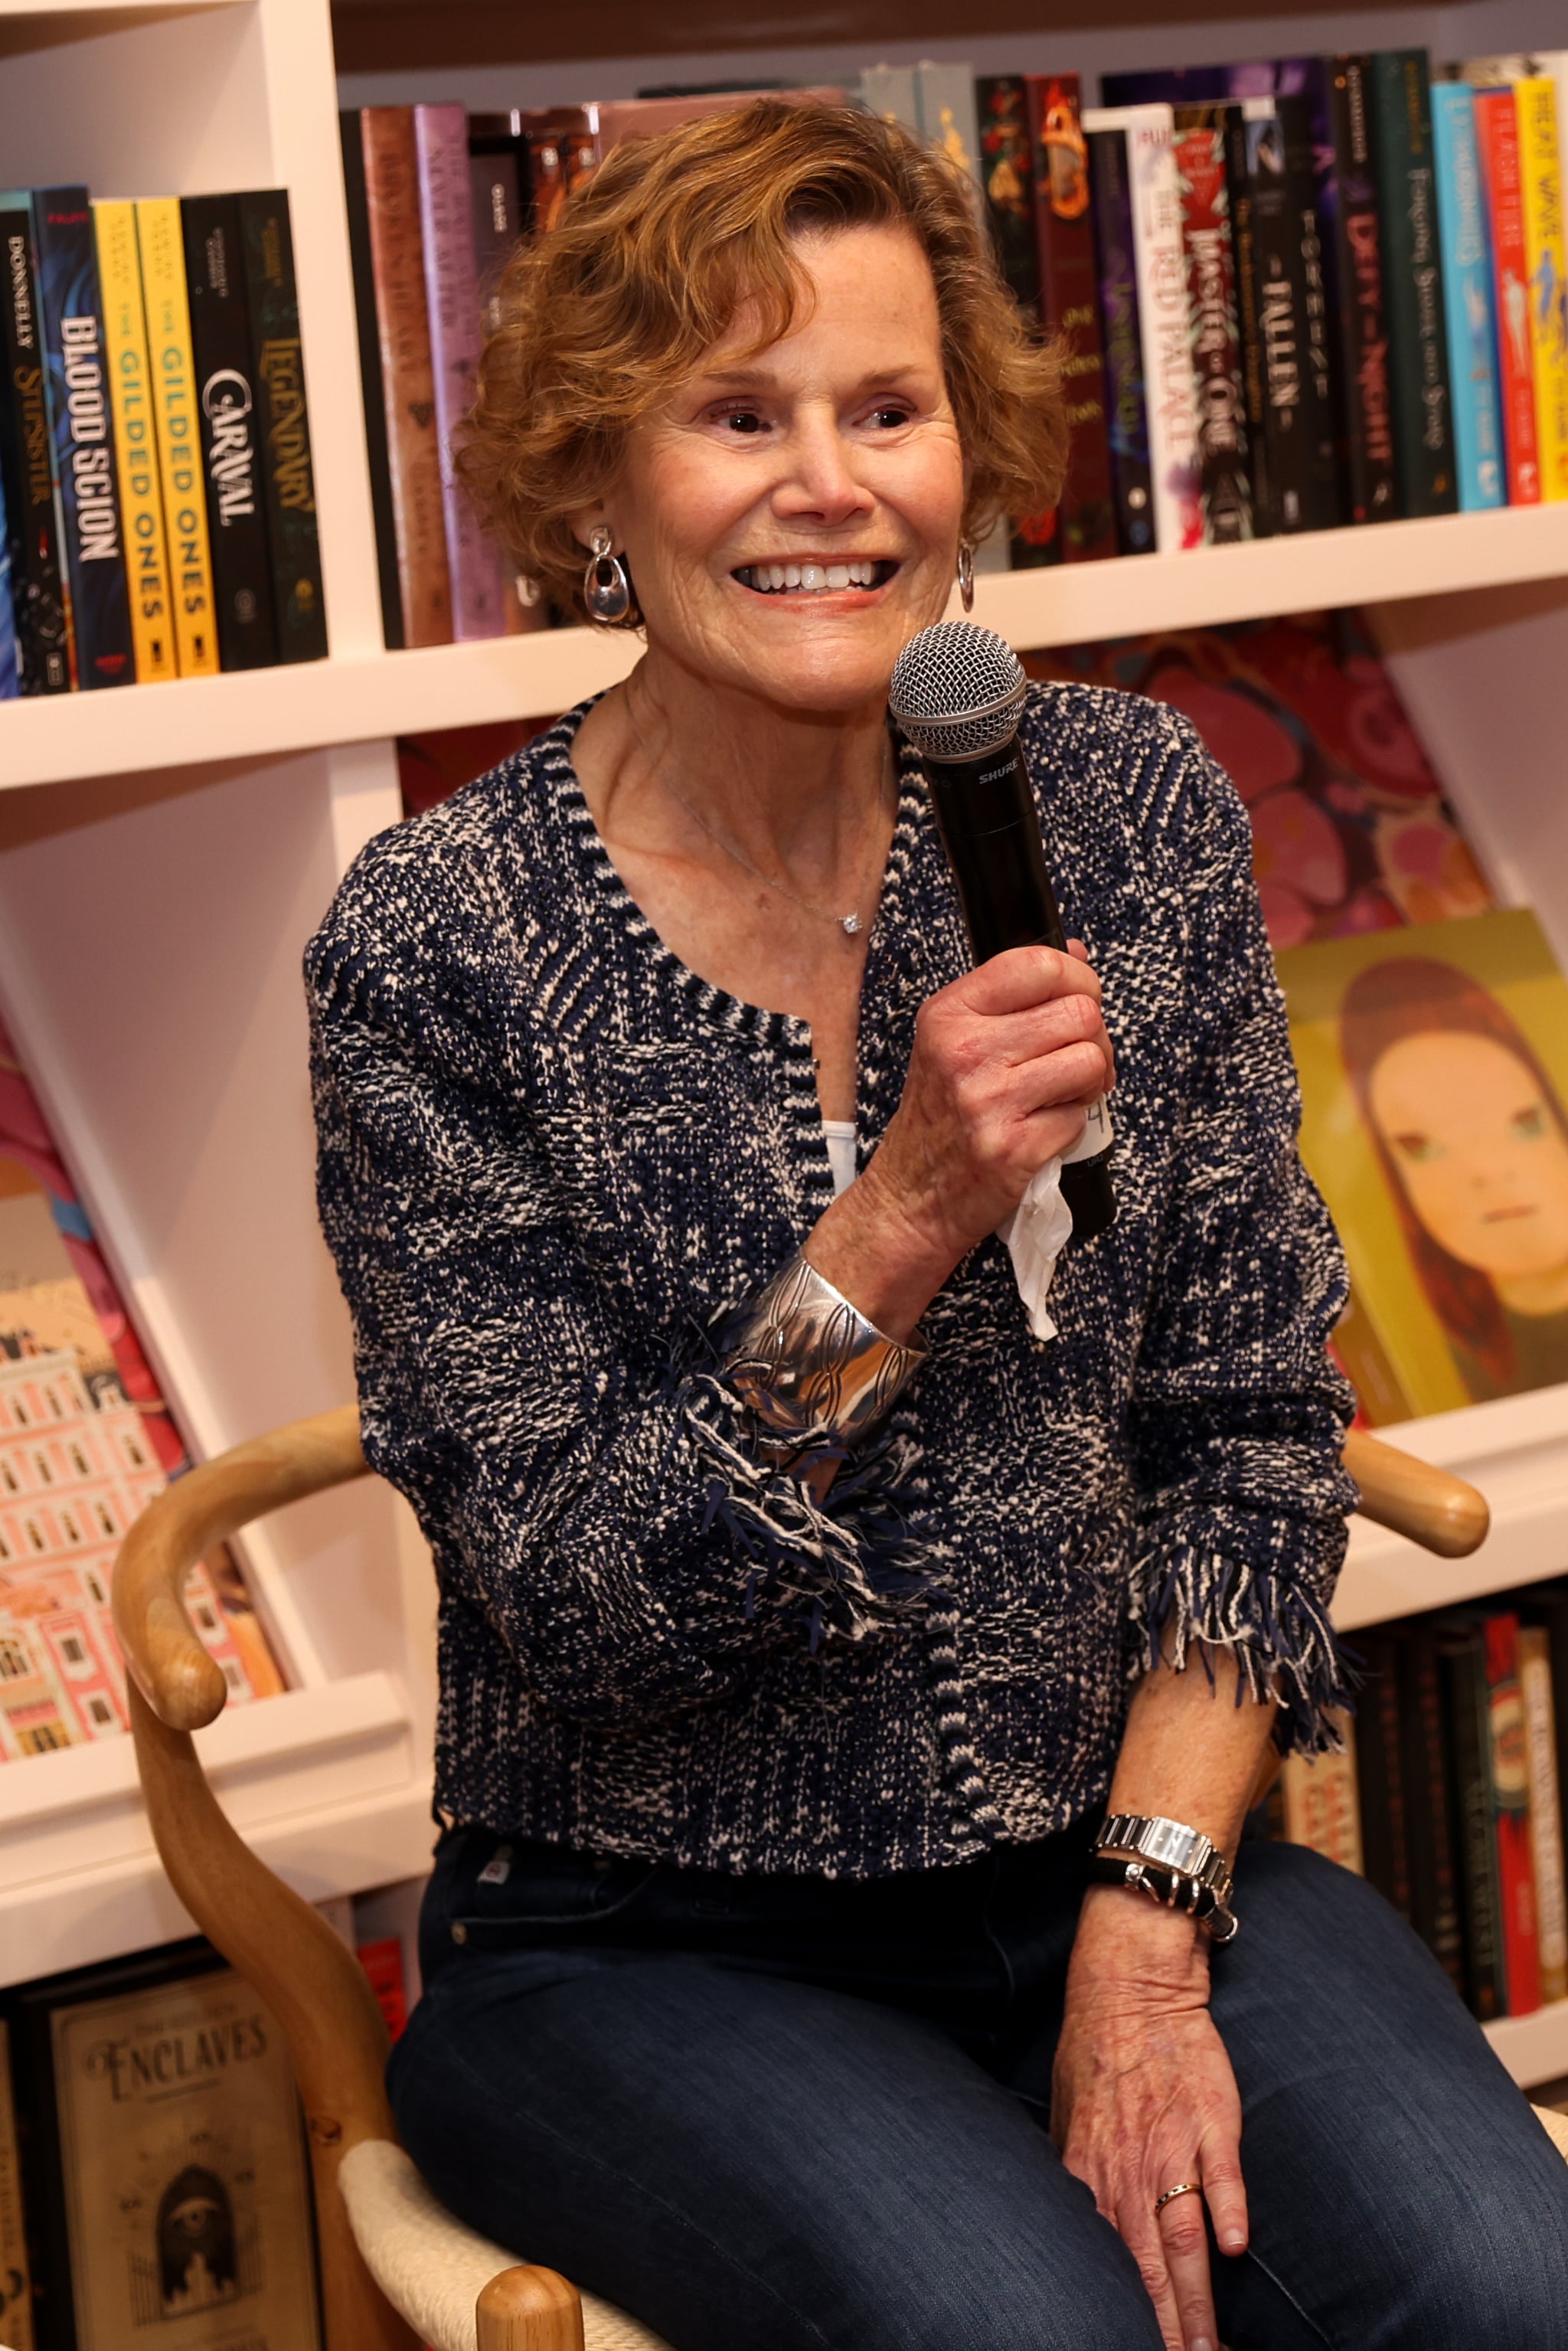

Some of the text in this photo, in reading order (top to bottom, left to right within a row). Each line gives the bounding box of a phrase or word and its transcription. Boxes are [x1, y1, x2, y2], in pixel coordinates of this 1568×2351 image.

[1536, 91, 1559, 239] HEAT WAVE
[8, 234, 34, 349] DONNELLY
[1152, 244, 1187, 305] RED
[1185, 231, 1226, 355] MASTER
[1155, 319, 1197, 451] PALACE
[1259, 280, 1300, 408] FALLEN
[1354, 338, 1393, 463] NIGHT
[60, 315, 119, 563] BLOOD SCION
[162, 345, 195, 495] GILDED
[120, 350, 150, 496] GILDED
[135, 512, 163, 621] ONES
[176, 508, 207, 617] ONES
[978, 757, 1019, 785] SHURE
[1088, 1101, 1104, 1134] 4
[85, 2013, 269, 2104] ENCLAVES
